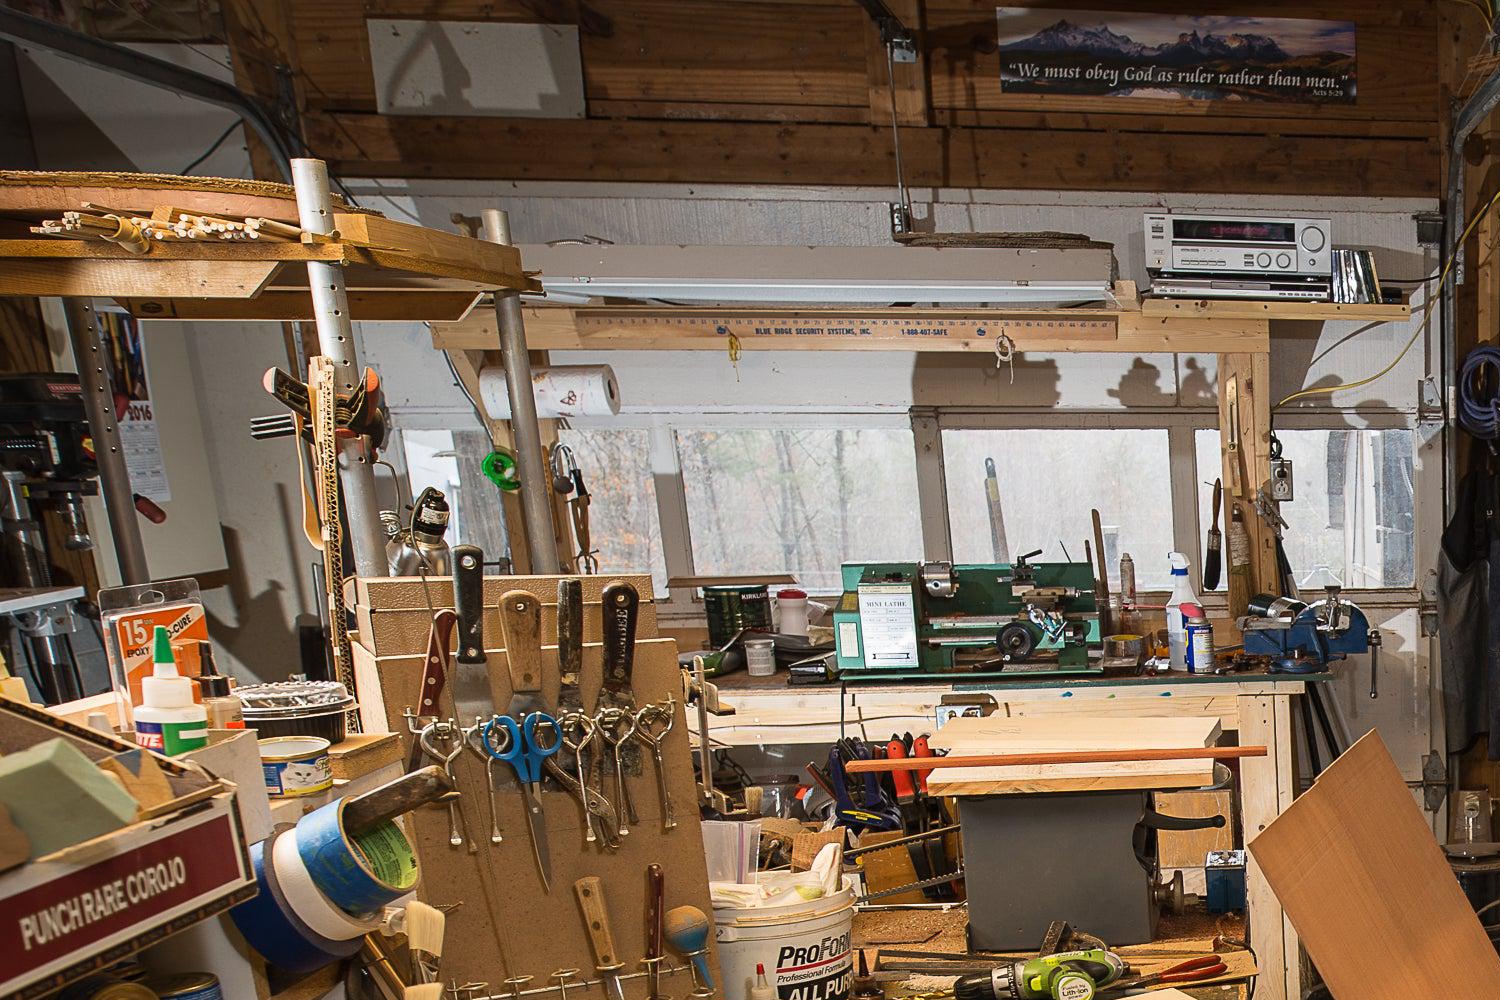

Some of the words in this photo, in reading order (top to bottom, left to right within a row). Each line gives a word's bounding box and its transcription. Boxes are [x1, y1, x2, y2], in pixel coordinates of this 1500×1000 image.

[1043, 65, 1080, 79] must
[1085, 63, 1120, 87] obey
[1123, 65, 1154, 82] God
[1157, 71, 1173, 82] as
[1177, 67, 1215, 84] ruler
[1218, 69, 1264, 86] rather
[1267, 70, 1301, 87] than
[1304, 74, 1349, 89] men.”
[1312, 89, 1327, 97] Acts
[122, 618, 147, 646] 15
[126, 646, 150, 659] EPOXY
[18, 892, 84, 951] PUNCH
[82, 880, 129, 925] RARE
[125, 856, 187, 903] COROJO
[777, 968, 824, 984] Professional
